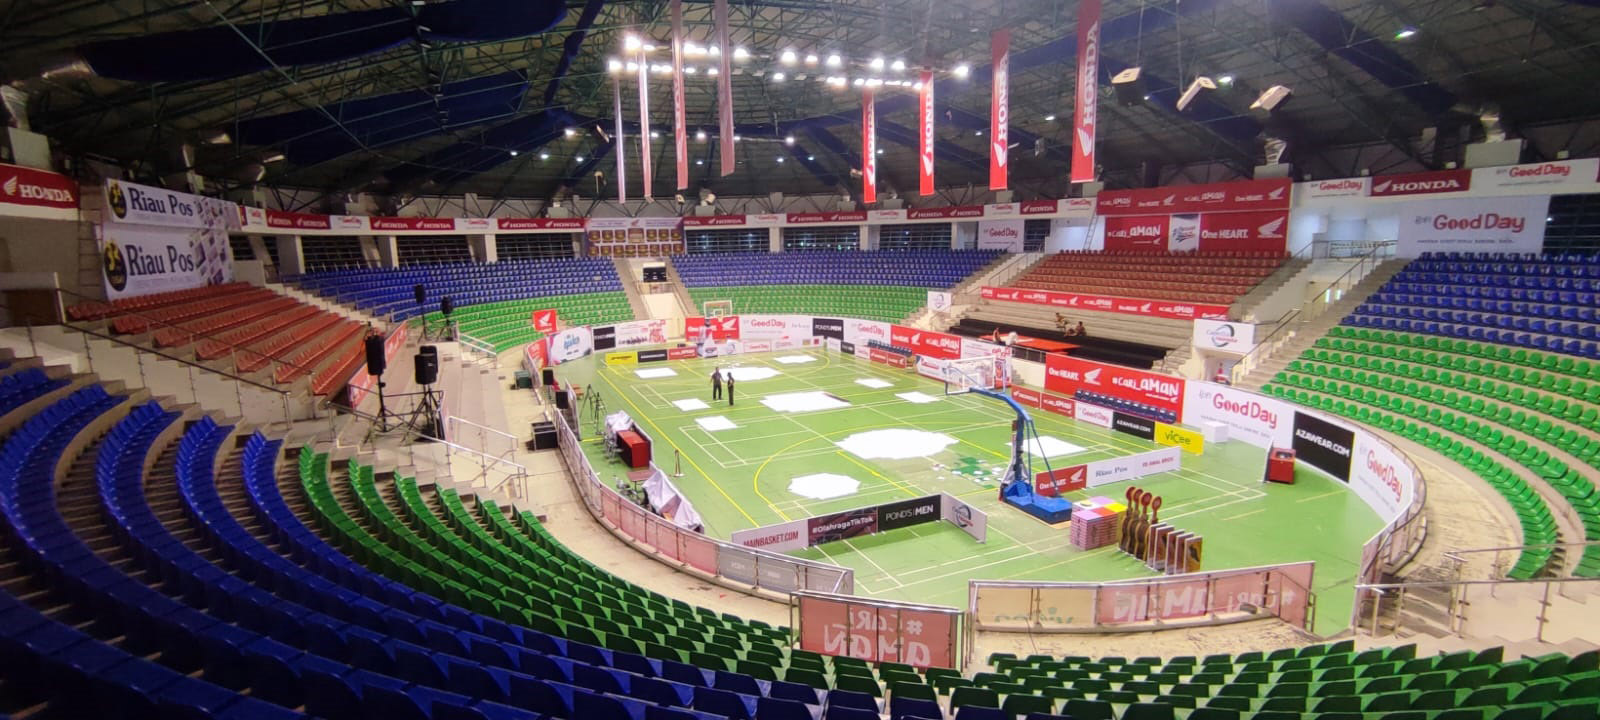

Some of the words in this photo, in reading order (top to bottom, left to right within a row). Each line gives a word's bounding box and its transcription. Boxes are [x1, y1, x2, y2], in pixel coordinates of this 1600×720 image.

[1083, 20, 1098, 127] HONDA
[1509, 165, 1543, 177] Good
[1543, 163, 1571, 176] Day
[18, 183, 75, 202] HONDA
[1391, 179, 1460, 192] HONDA
[127, 187, 166, 214] Riau
[167, 194, 194, 217] Pos
[1433, 214, 1483, 230] Good
[1484, 213, 1526, 233] Day
[1201, 229, 1218, 239] One
[125, 244, 166, 276] Riau
[166, 245, 194, 273] Pos
[751, 318, 771, 327] Good
[771, 318, 786, 328] Day
[1048, 367, 1060, 378] One
[1213, 392, 1250, 416] Good
[1250, 401, 1278, 429] Day
[1295, 429, 1351, 458] AZAWEAR.COM
[1095, 469, 1113, 478] Riau
[1114, 466, 1128, 474] Pos
[1367, 449, 1389, 481] Good
[1386, 464, 1403, 503] Day
[1039, 482, 1049, 490] One
[914, 503, 934, 516] MEN
